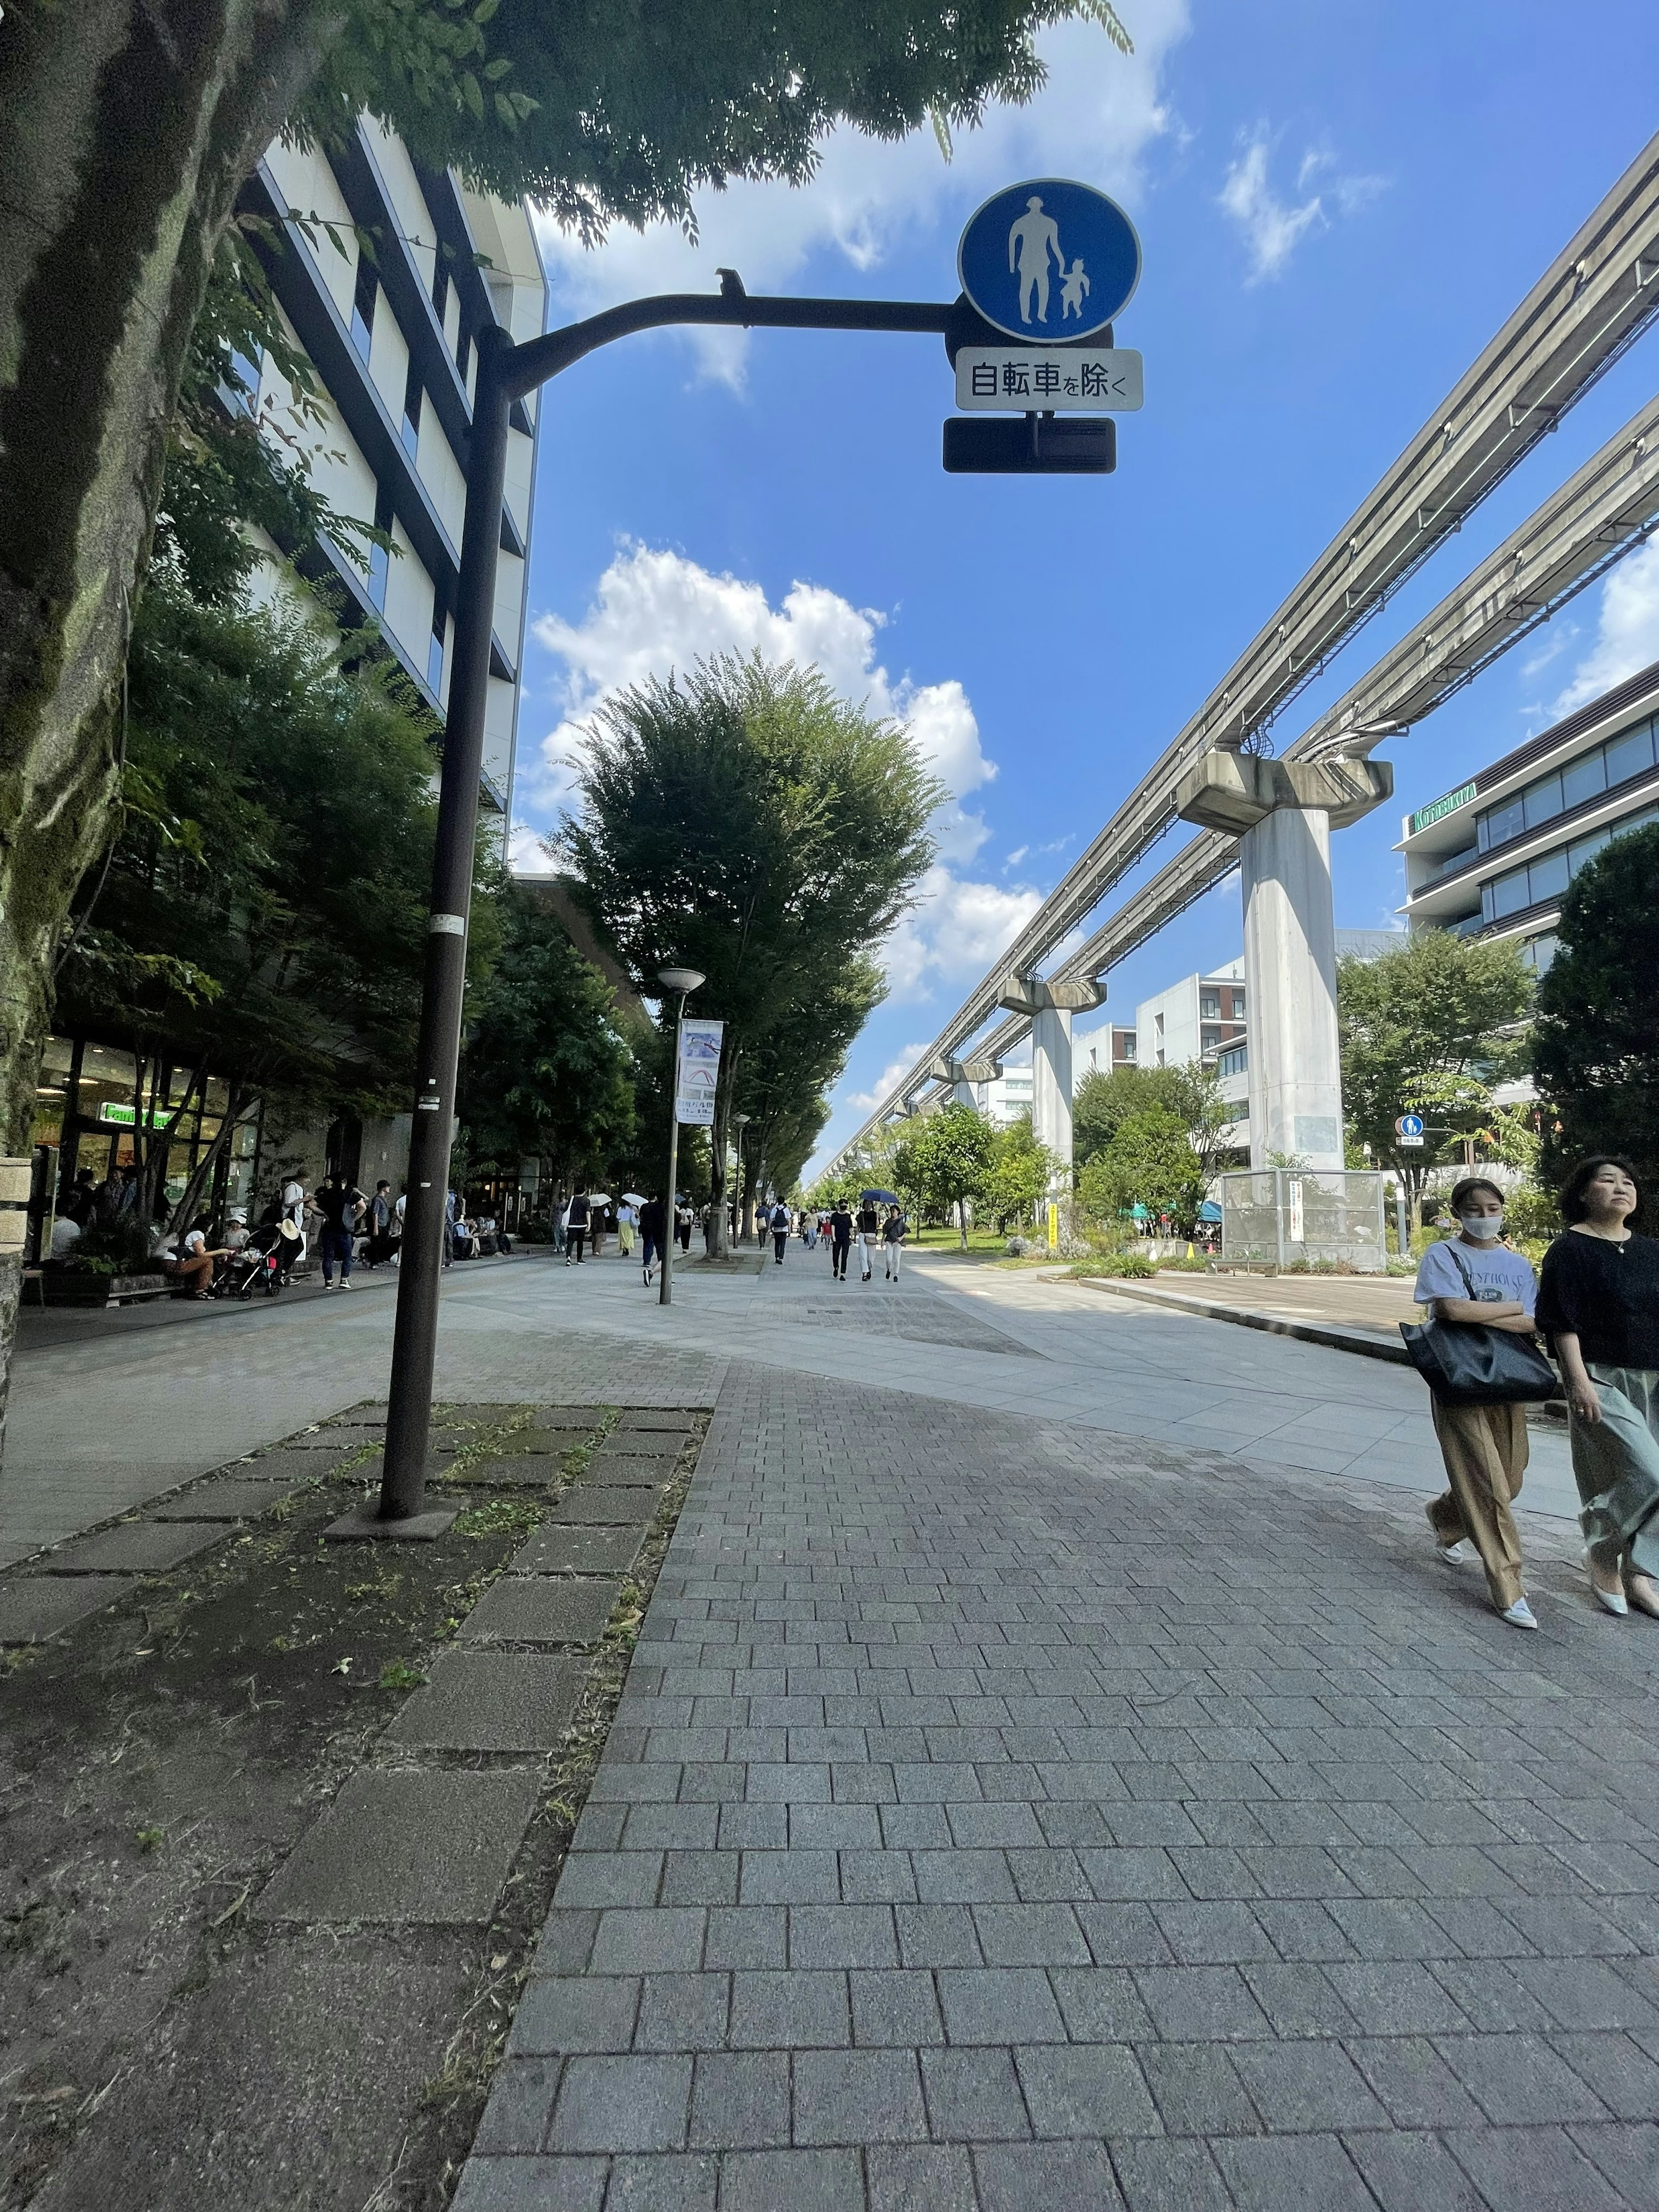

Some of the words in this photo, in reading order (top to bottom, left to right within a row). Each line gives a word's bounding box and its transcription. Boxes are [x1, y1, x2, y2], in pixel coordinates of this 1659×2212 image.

[972, 361, 1126, 397] 自転車を除く
